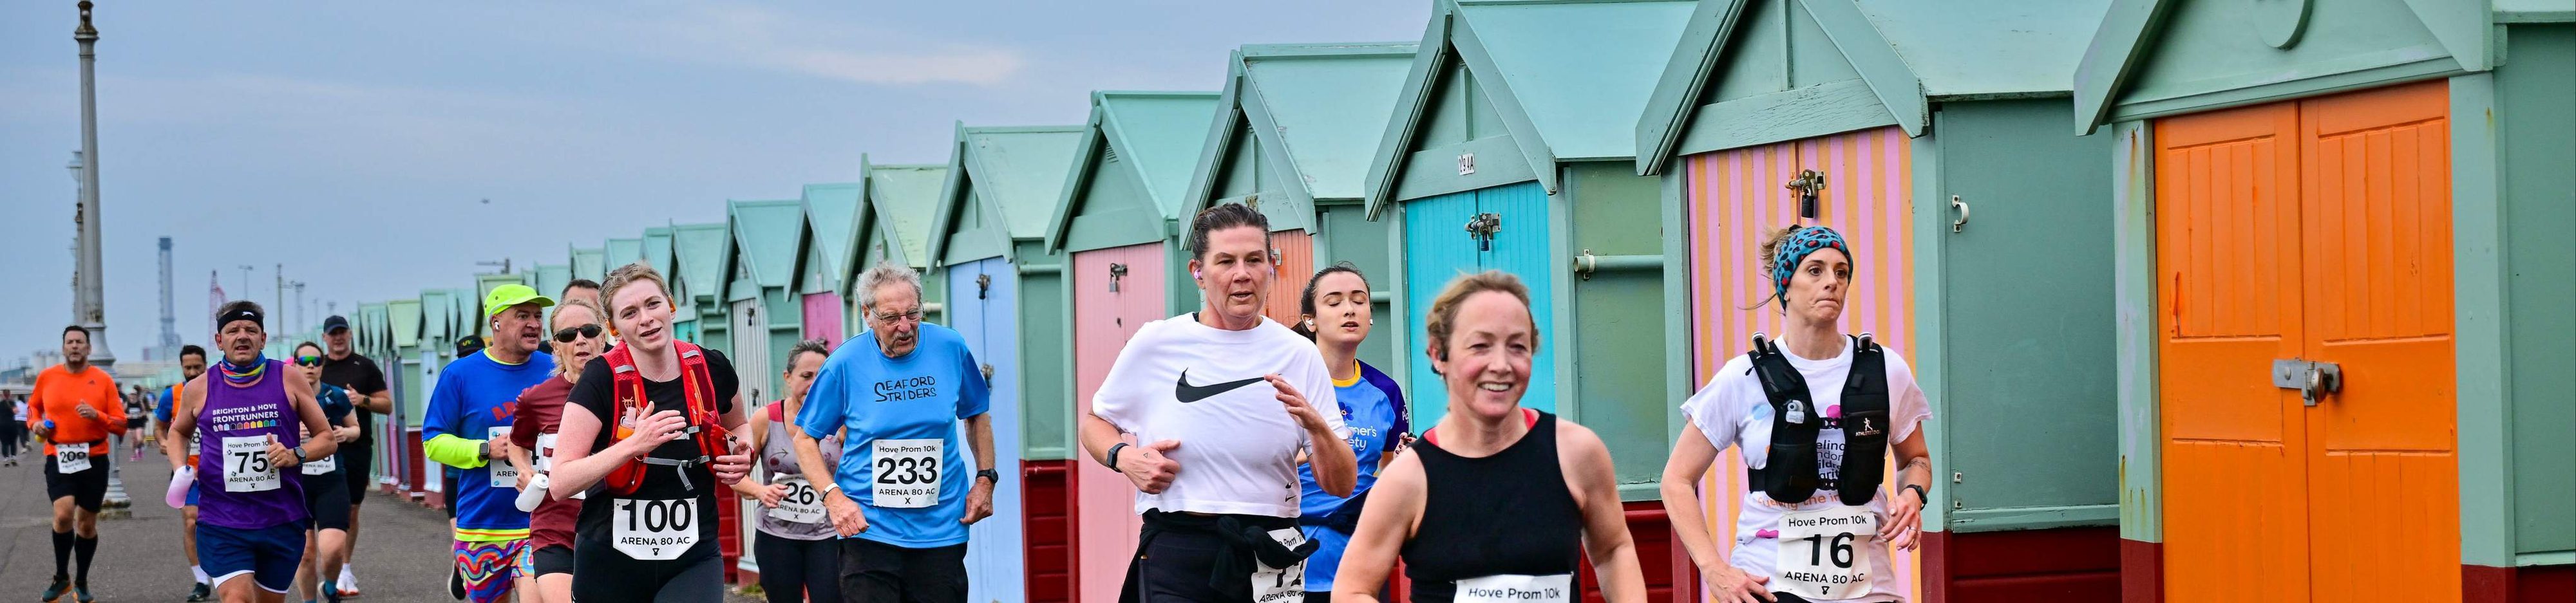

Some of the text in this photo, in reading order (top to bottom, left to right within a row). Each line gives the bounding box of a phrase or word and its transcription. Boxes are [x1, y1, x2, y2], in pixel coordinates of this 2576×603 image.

[213, 407, 249, 415] BRIGHTON
[213, 411, 279, 423] FRONTRUNNERS
[235, 450, 268, 474] 75
[877, 456, 937, 485] 233
[783, 482, 815, 505] 26
[622, 499, 692, 533] 100
[1788, 515, 1867, 527] Hove Prom 10k
[621, 537, 658, 545] ARENA
[676, 536, 690, 545] AC
[1803, 532, 1855, 569] 16
[1785, 571, 1864, 584] ARENA 80 AC
[1468, 588, 1560, 600] Hove Prom 10k
